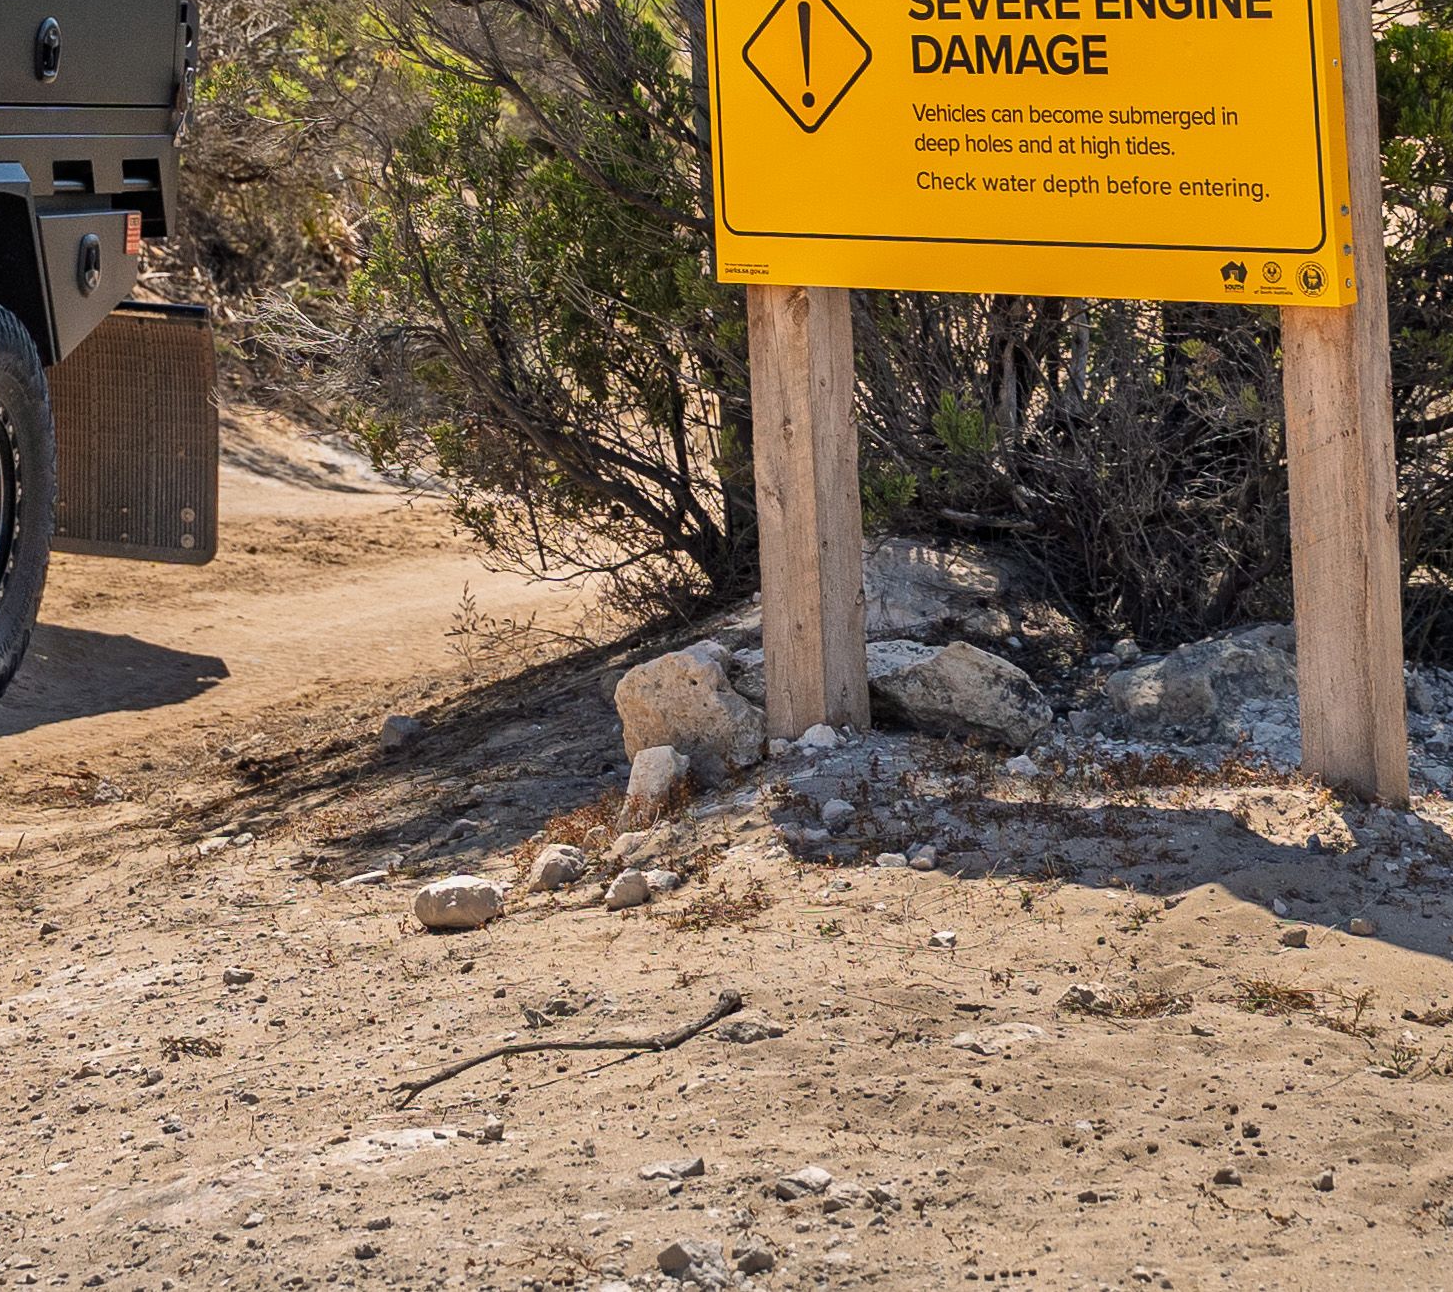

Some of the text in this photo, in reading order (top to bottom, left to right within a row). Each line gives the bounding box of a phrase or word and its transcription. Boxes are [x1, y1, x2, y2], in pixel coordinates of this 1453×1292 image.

[911, 33, 1109, 76] DAMAGE
[912, 103, 1238, 130] Vehicles can become submerged in
[914, 134, 1175, 160] deep holes and at high tides.
[916, 171, 1270, 203] Check water depth before entering.
